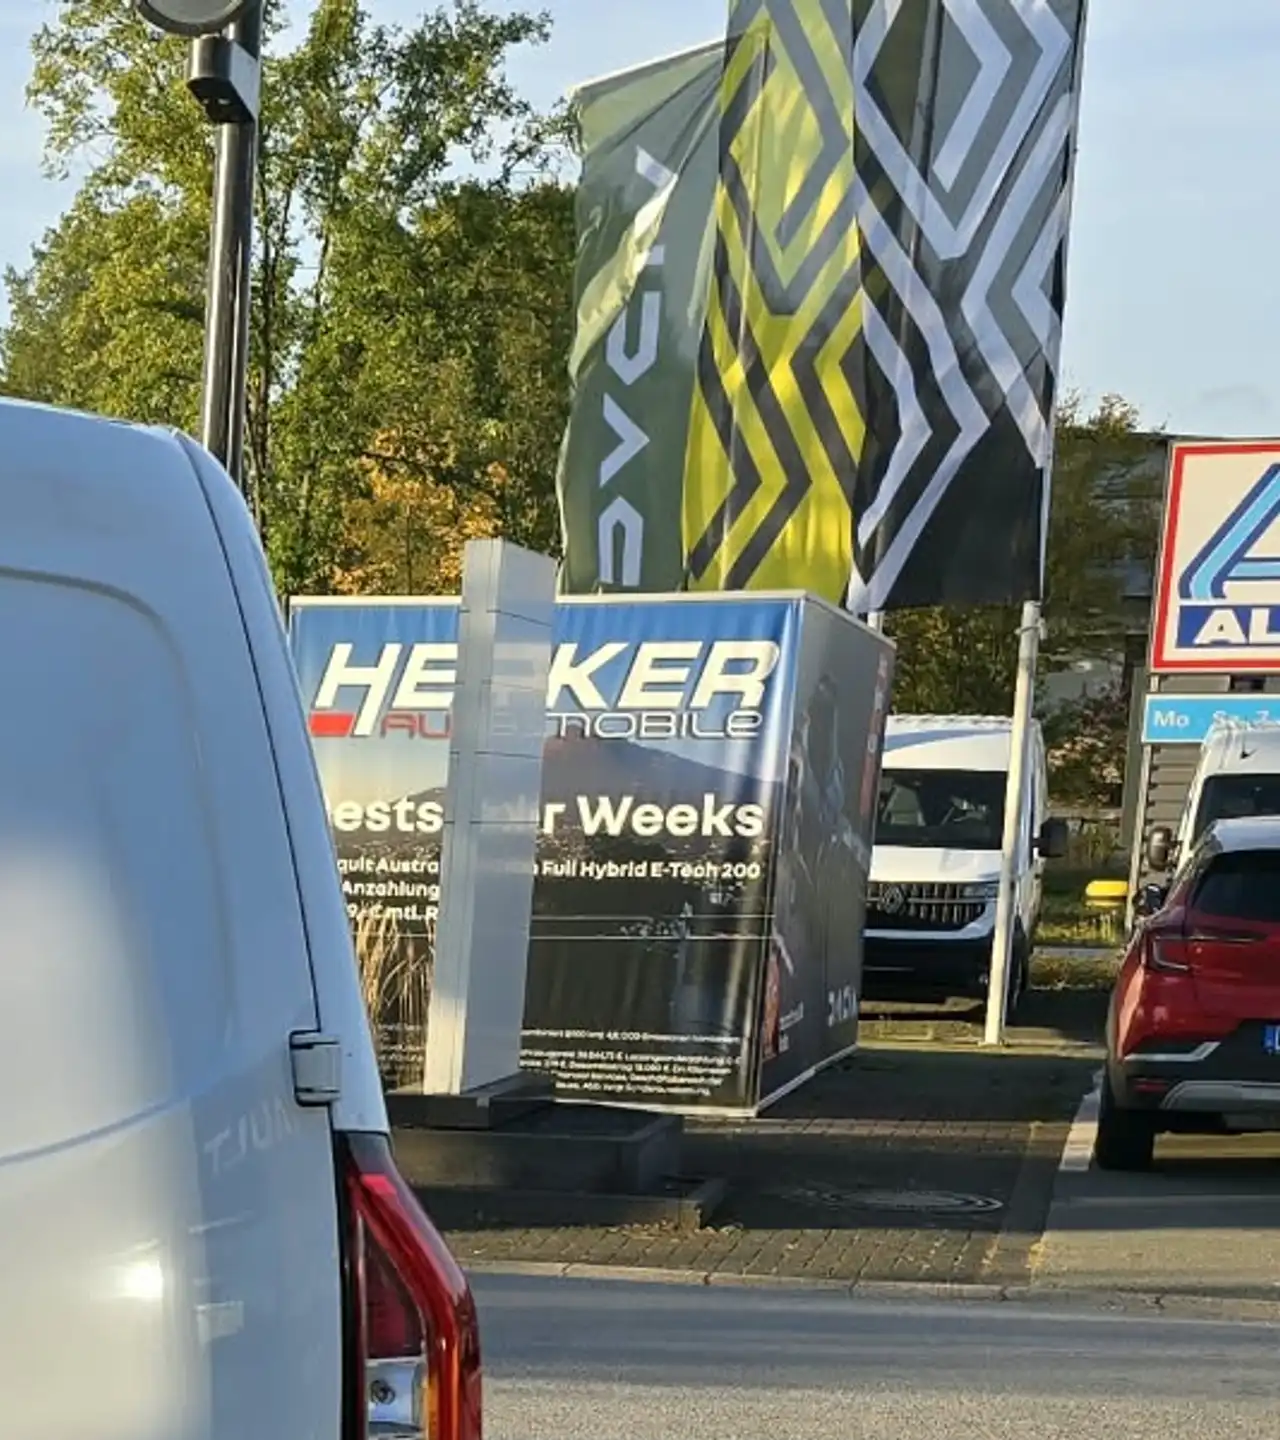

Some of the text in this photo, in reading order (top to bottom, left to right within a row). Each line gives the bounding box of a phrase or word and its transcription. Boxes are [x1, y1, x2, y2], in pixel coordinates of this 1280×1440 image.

[1193, 608, 1280, 644] AL
[315, 640, 781, 737] HEKER
[1154, 710, 1189, 728] Mo
[576, 793, 764, 837] Weeks
[375, 857, 439, 874] Austra
[542, 861, 576, 878] Full
[579, 861, 648, 880] Hybrid
[651, 863, 718, 879] E-Tech
[721, 864, 761, 880] 200
[342, 880, 440, 901] Anzahlung
